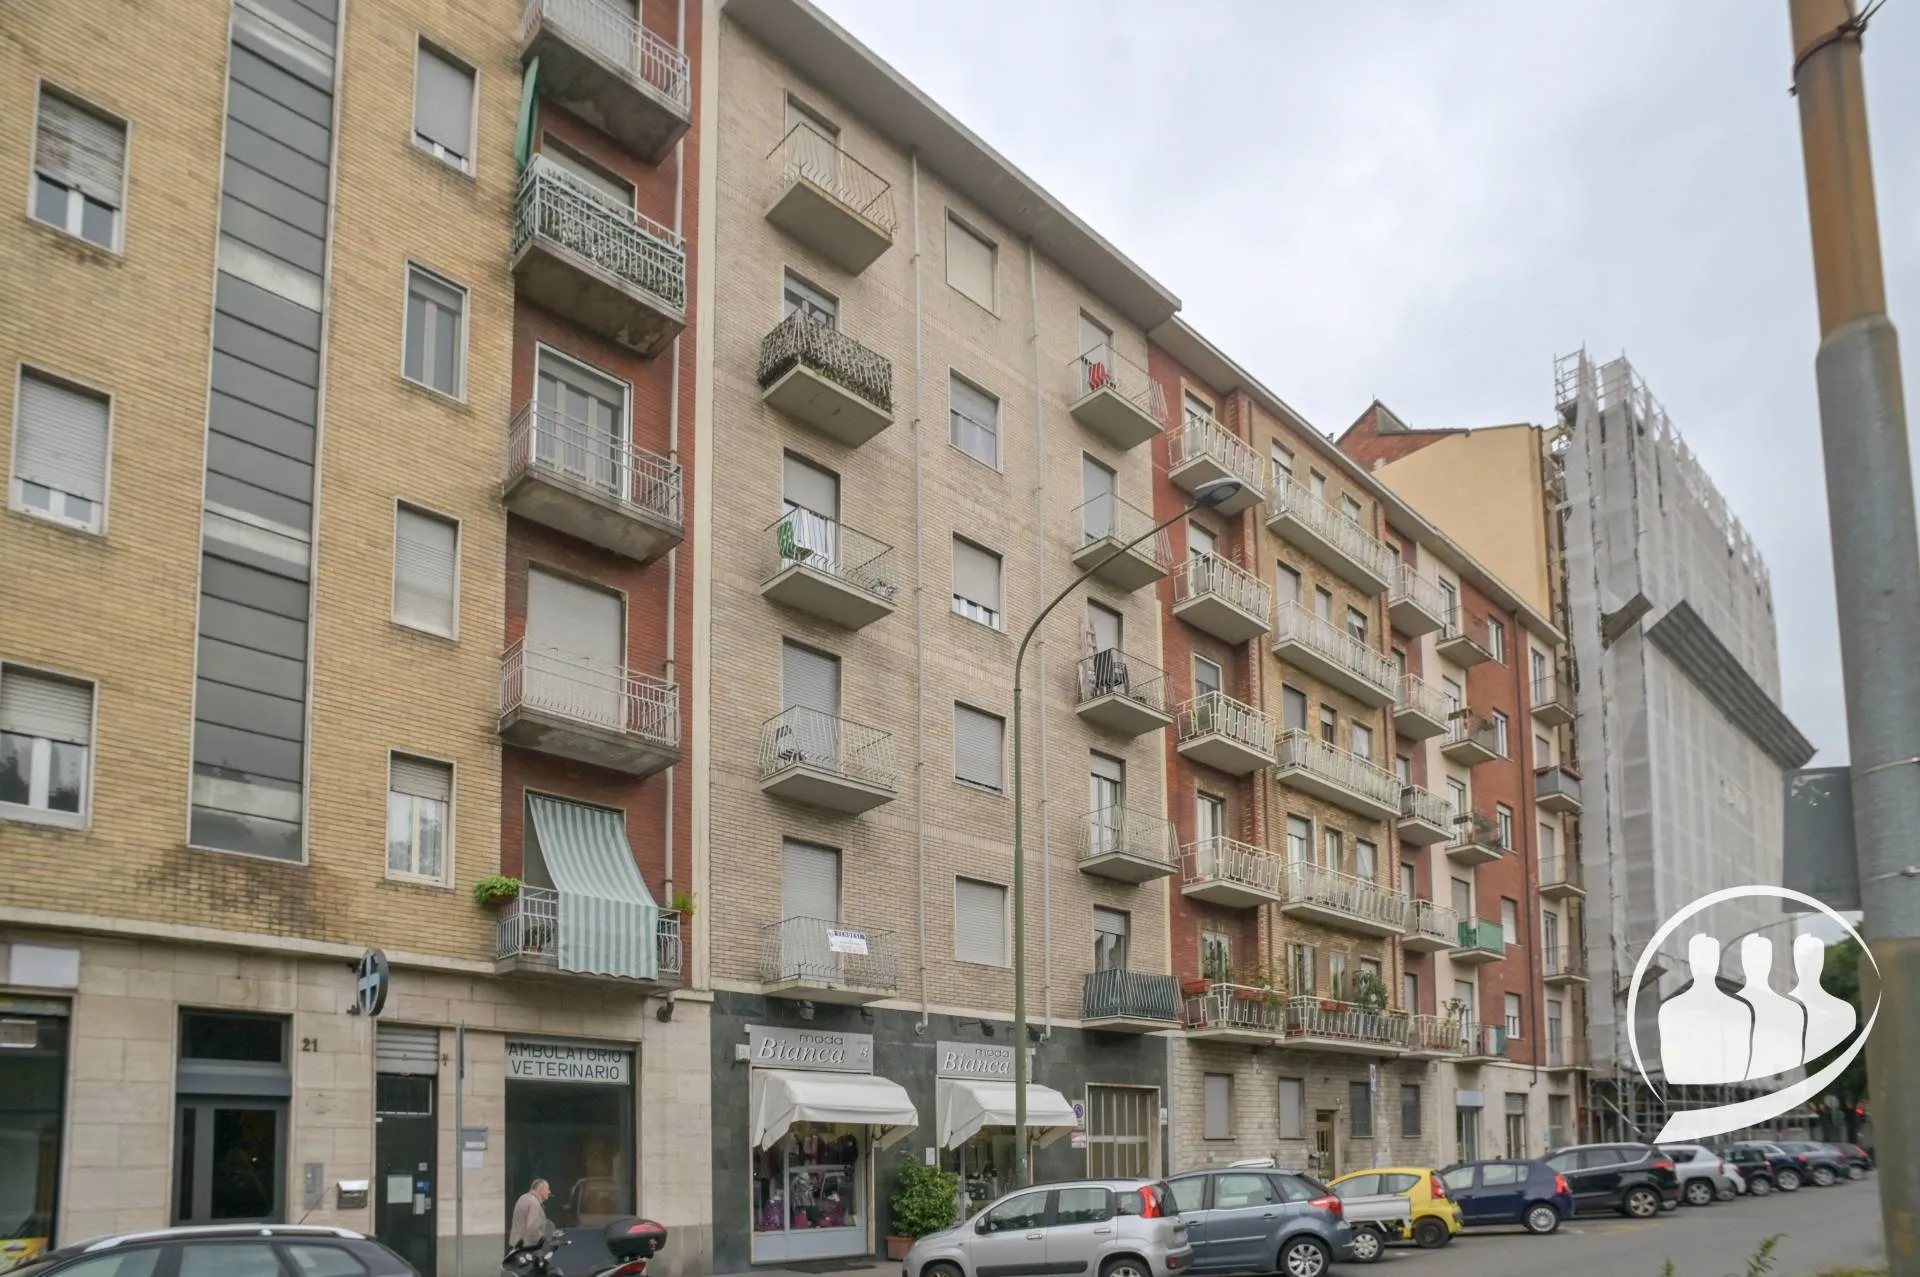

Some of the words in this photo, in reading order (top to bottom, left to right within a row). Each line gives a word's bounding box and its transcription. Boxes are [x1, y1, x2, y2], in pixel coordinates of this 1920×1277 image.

[302, 1037, 318, 1053] 21
[758, 1037, 845, 1063] Bianca
[799, 1034, 844, 1046] moda
[508, 1042, 622, 1063] AMBULATORIO
[943, 1051, 1010, 1074] Bianca
[975, 1049, 1010, 1058] moda
[511, 1060, 620, 1080] VETERINARIO
